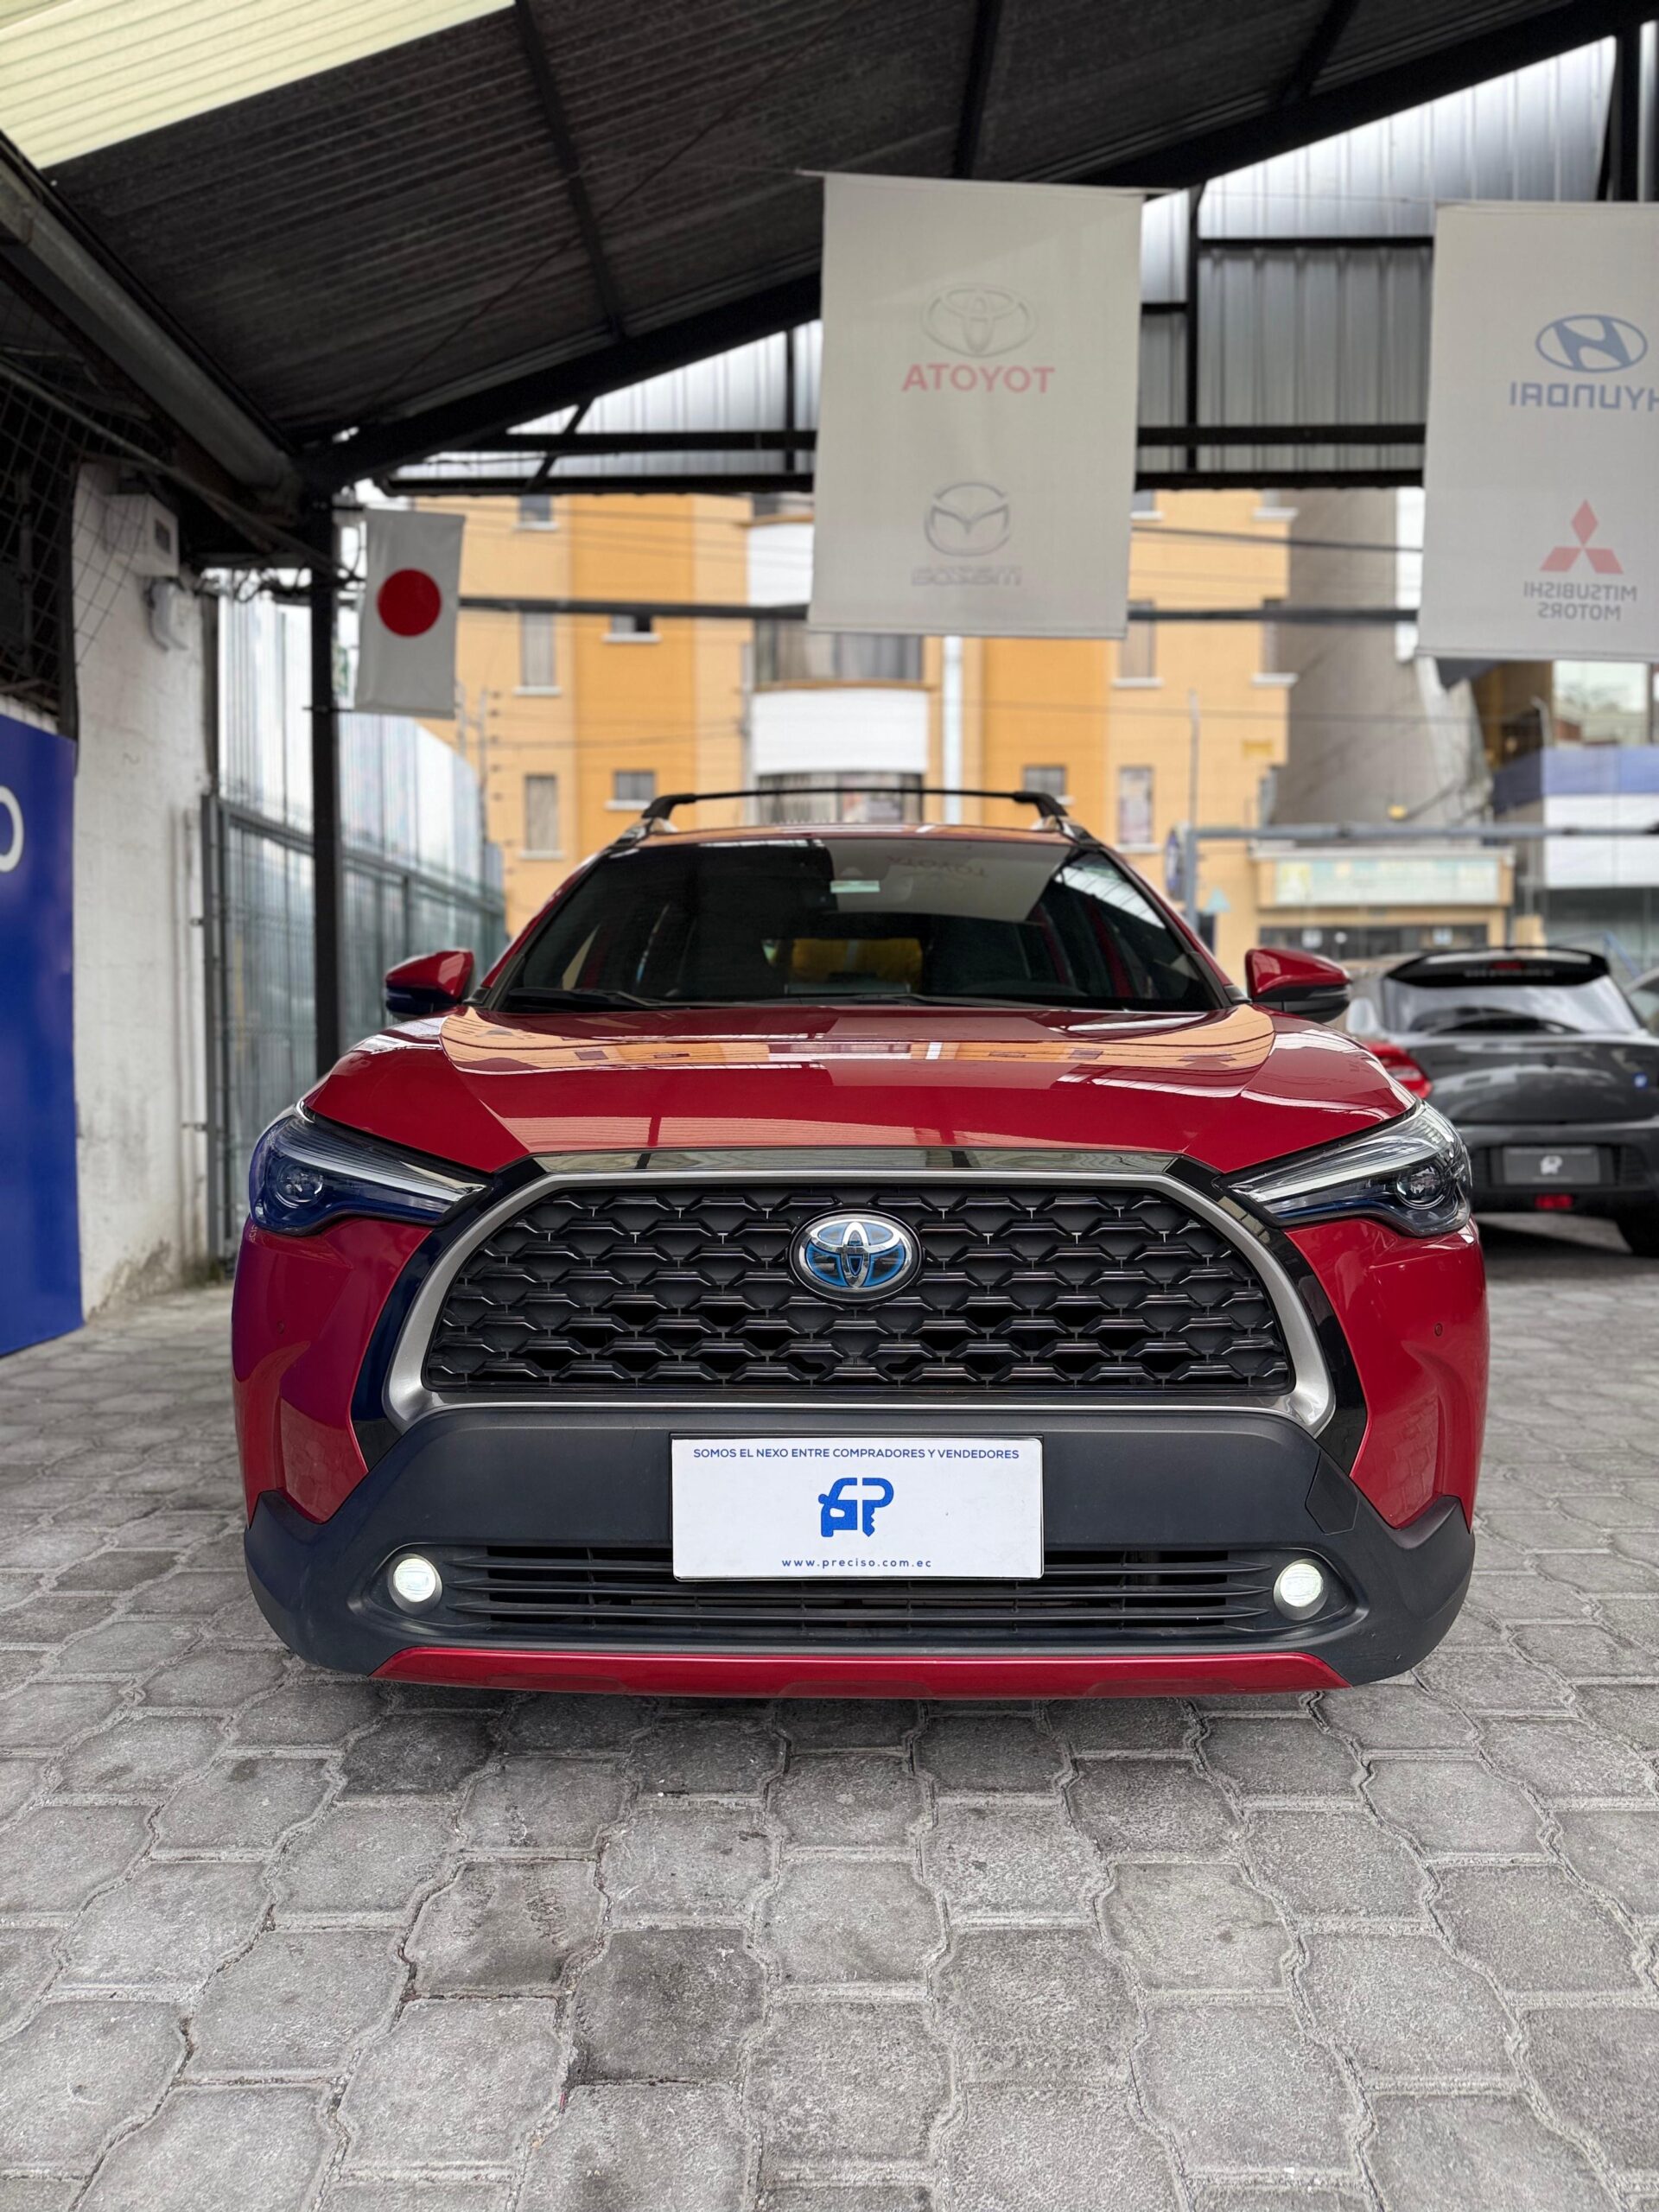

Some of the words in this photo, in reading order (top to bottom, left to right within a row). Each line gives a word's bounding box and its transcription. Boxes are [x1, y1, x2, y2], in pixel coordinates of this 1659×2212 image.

[693, 1448, 737, 1459] SOMOS
[740, 1448, 754, 1458] EL
[756, 1448, 789, 1458] NEXO
[791, 1448, 830, 1458] ENTRE
[832, 1448, 925, 1459] COMPRADORES
[927, 1449, 936, 1459] Y
[937, 1449, 1020, 1459] VENDEDORES
[781, 1558, 931, 1569] www.preciso.com.ec
